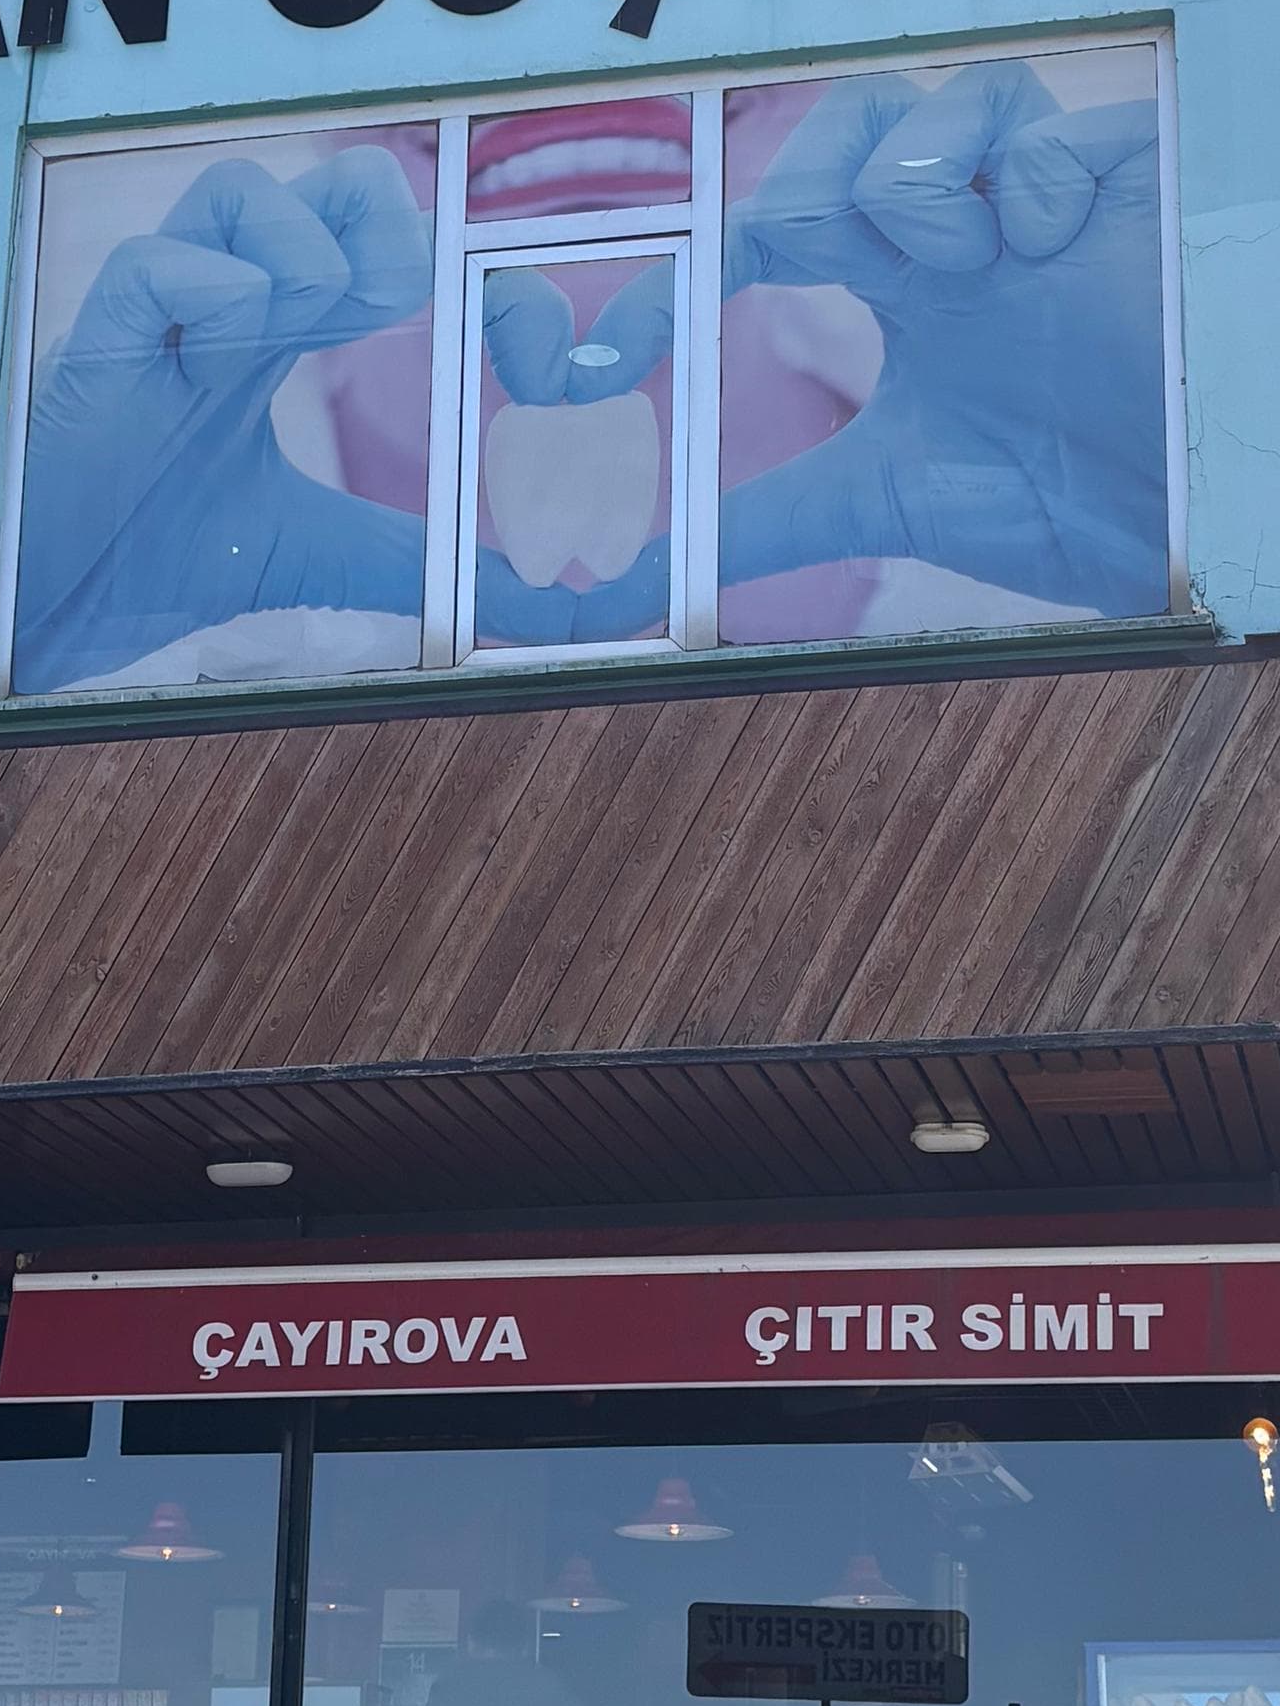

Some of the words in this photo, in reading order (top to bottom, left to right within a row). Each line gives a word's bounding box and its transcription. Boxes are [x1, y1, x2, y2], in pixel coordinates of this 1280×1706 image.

[192, 1315, 528, 1379] ÇAYIROVA
[743, 1303, 935, 1365] ÇITIR
[959, 1292, 1165, 1351] SİMİT
